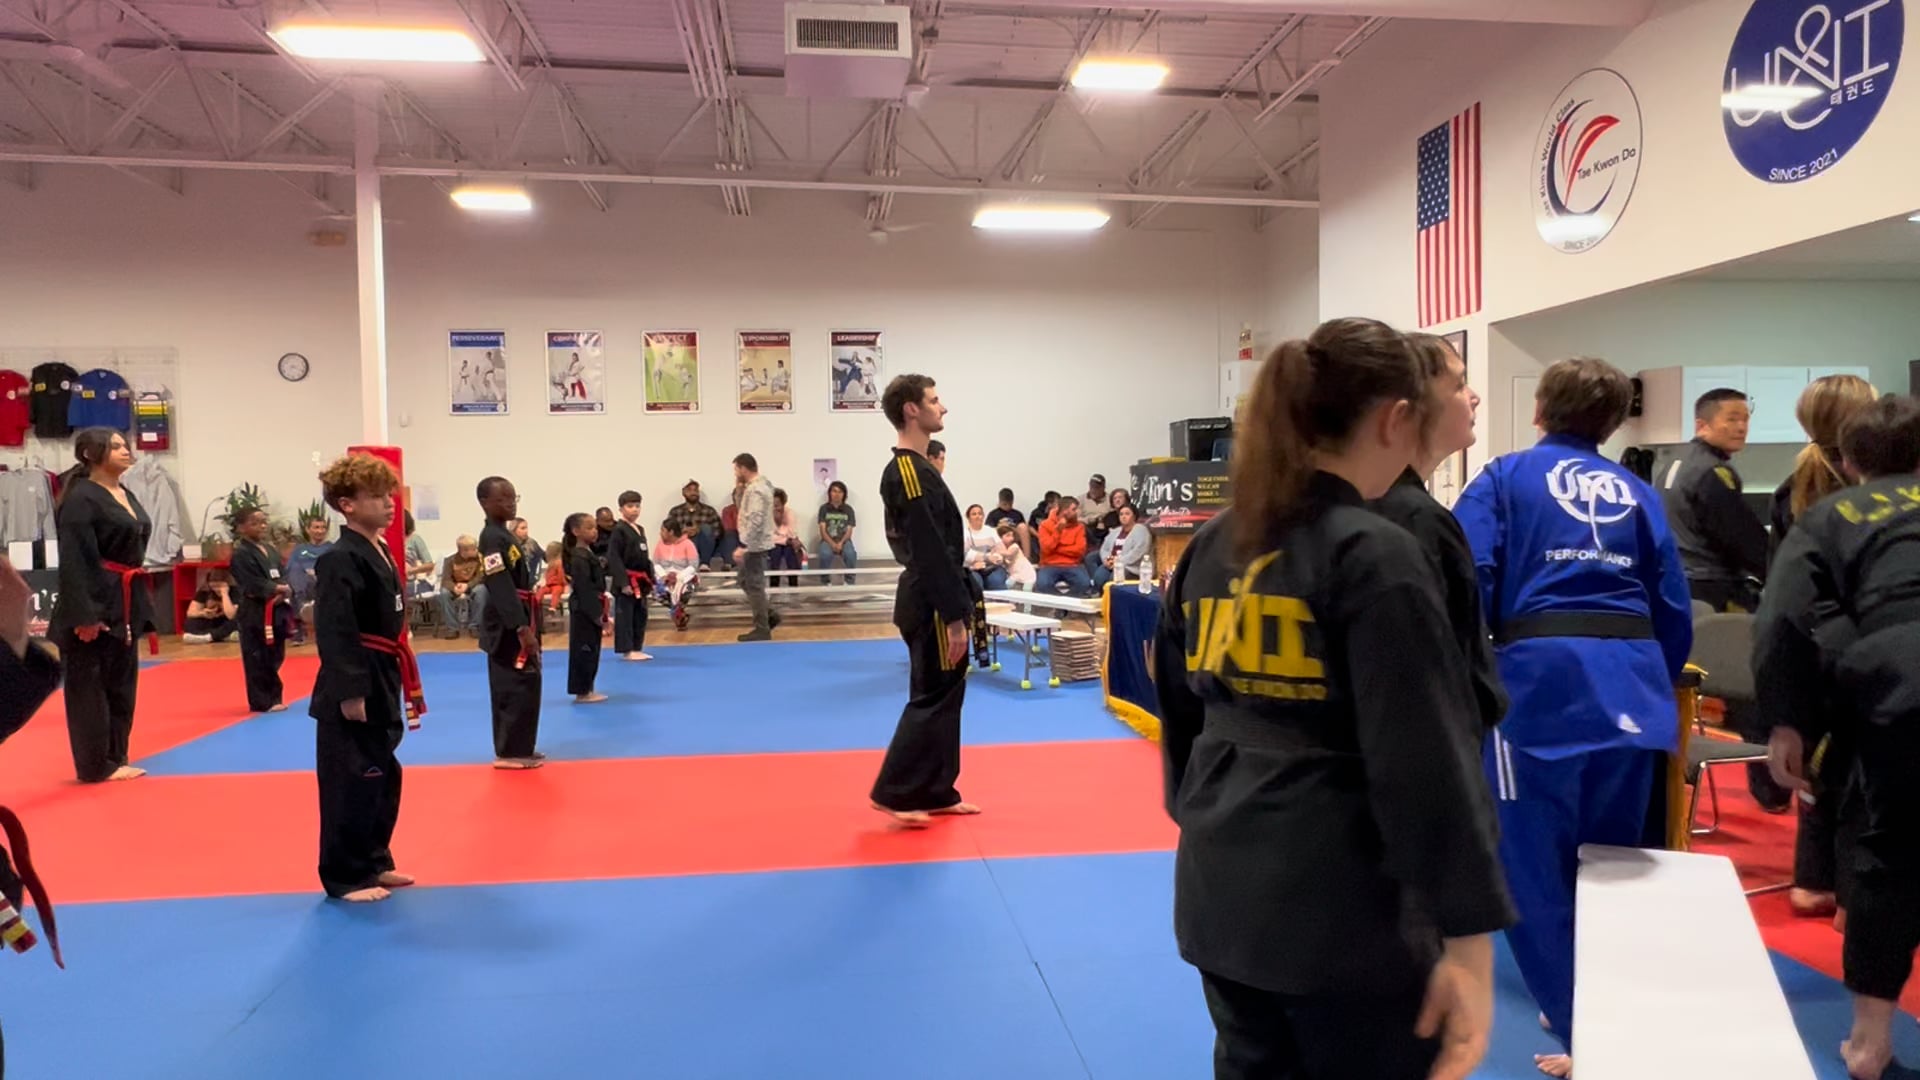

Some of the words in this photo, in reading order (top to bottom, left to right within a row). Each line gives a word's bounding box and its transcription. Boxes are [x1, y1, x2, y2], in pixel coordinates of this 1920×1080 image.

[1577, 168, 1591, 180] Tae
[1593, 155, 1619, 173] Kwon
[1622, 147, 1636, 161] Do
[1769, 165, 1807, 181] SINCE
[1809, 148, 1838, 174] 2021
